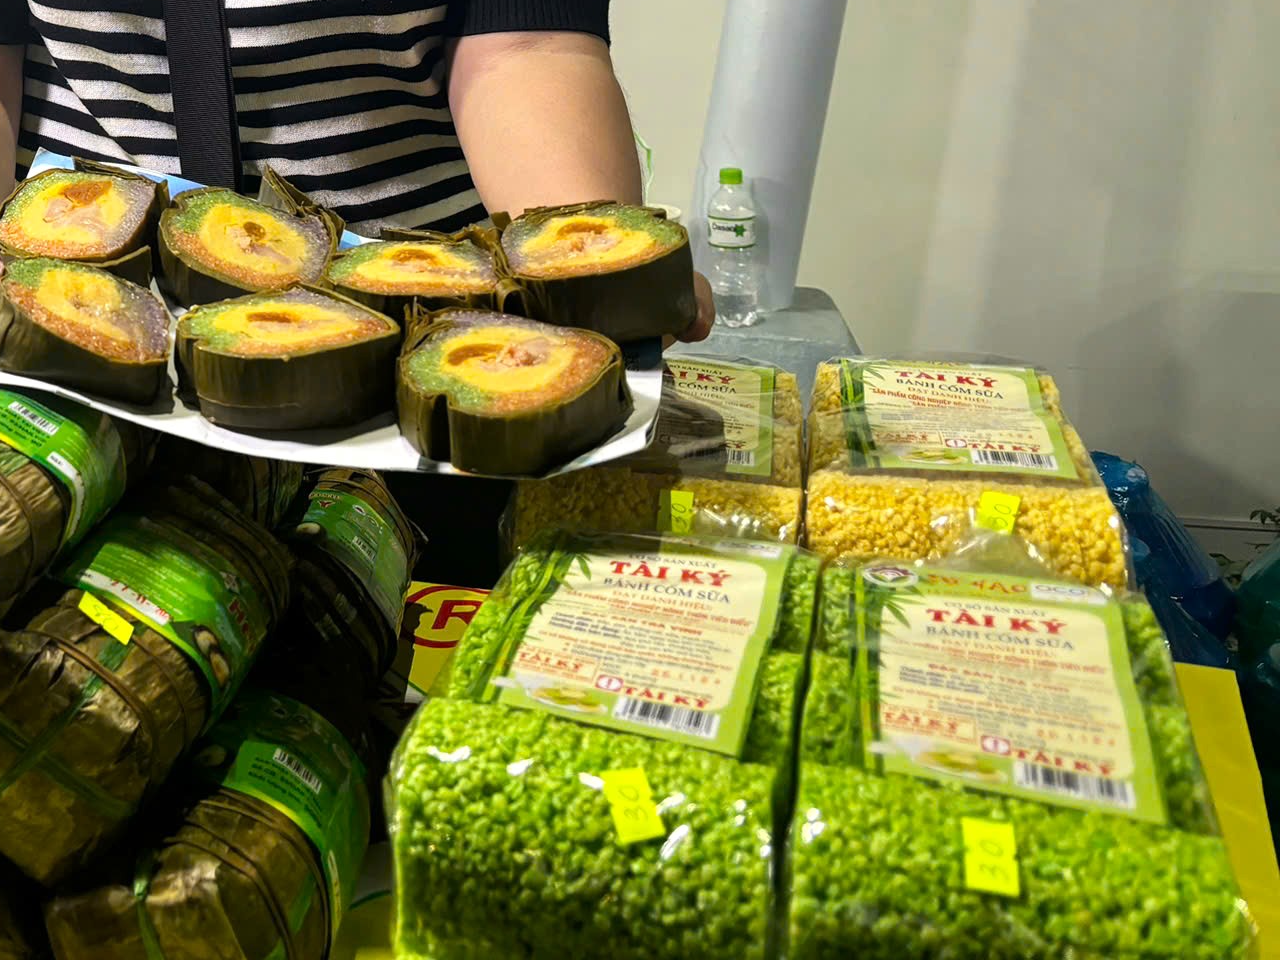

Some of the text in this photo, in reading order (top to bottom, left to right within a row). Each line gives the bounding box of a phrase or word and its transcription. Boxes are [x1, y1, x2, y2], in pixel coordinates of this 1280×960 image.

[696, 372, 737, 385] KÝ
[895, 370, 999, 389] TÀI KÝ
[896, 378, 1004, 400] BÁNH CỐM SỮA
[609, 559, 733, 588] TÀI KÝ
[603, 577, 732, 605] BÁNH CỐM SỮA
[926, 608, 1068, 636] TÀI KÝ
[925, 624, 980, 641] BÁNH
[1035, 635, 1076, 652] SỮA
[623, 687, 711, 709] TÀI KÝ
[1011, 748, 1117, 776] TÀI KÝ
